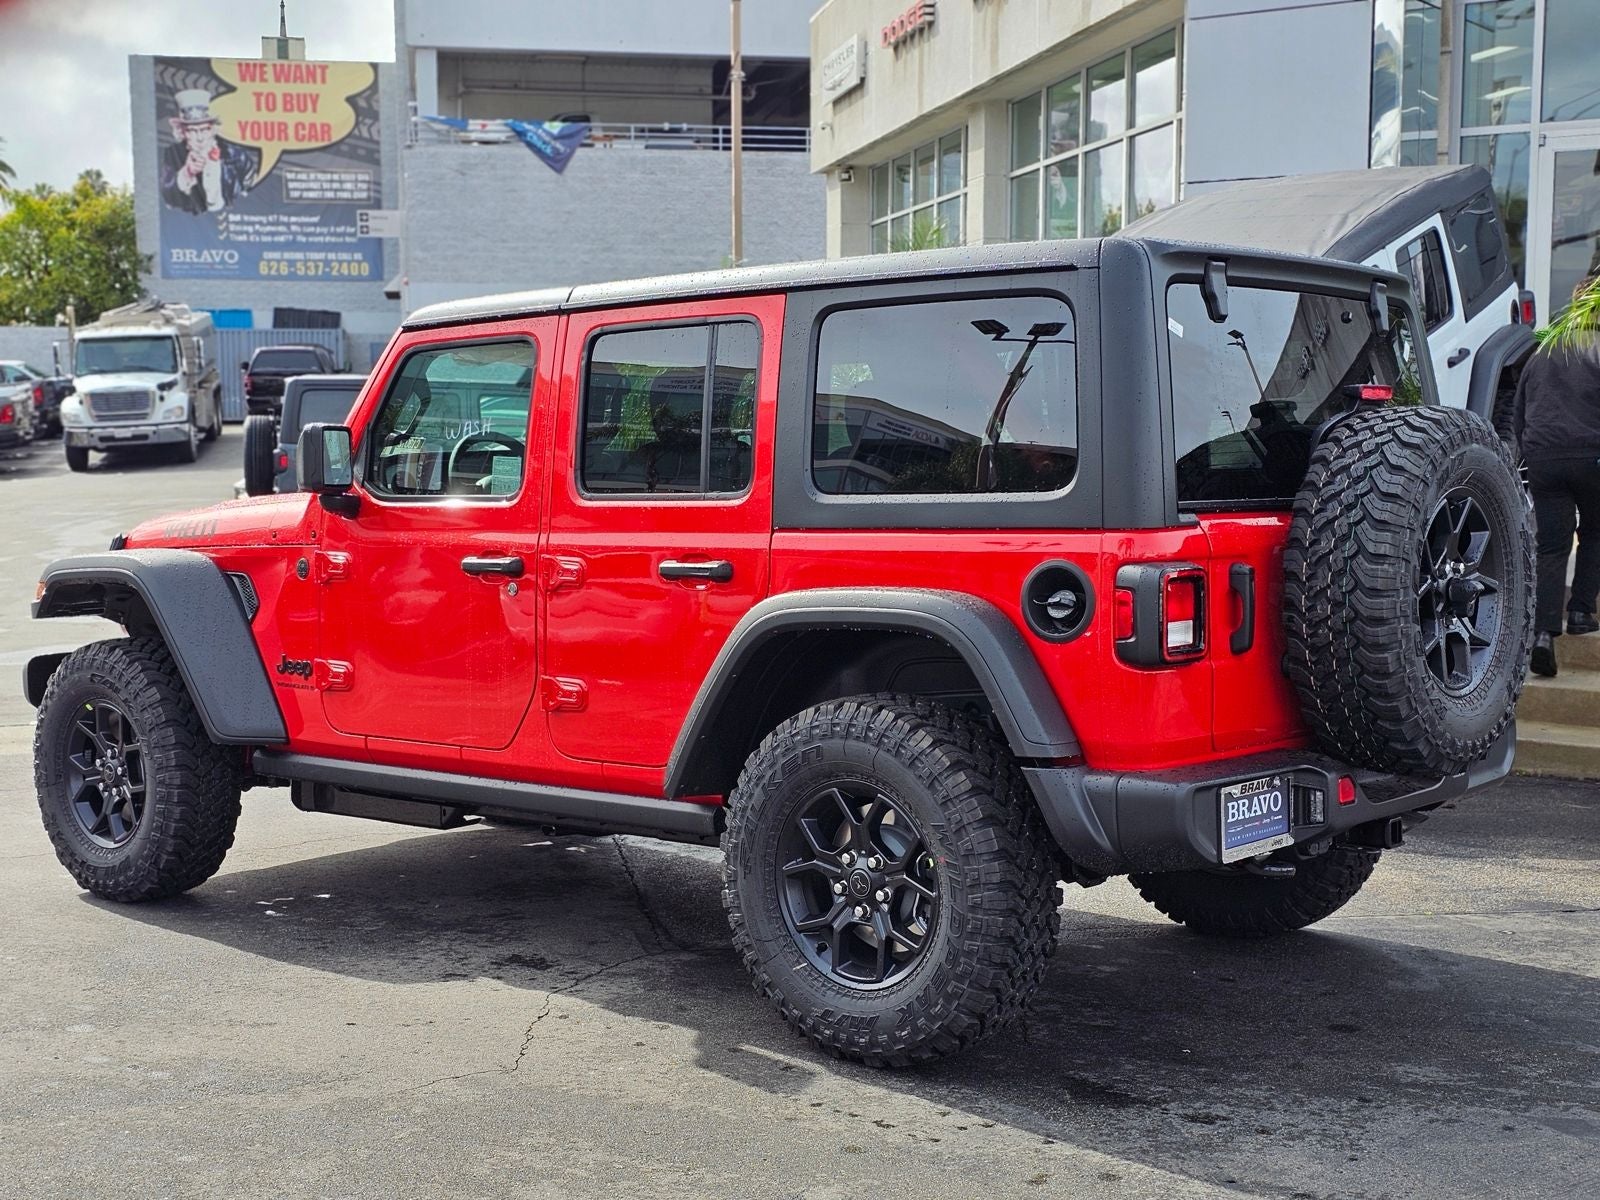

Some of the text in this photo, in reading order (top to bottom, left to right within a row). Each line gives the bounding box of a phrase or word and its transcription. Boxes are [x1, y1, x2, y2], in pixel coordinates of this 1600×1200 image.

[881, 0, 926, 48] DODGE
[237, 62, 329, 85] WE WANT
[252, 92, 320, 114] TO BUY
[238, 120, 332, 143] YOUR CAR
[171, 248, 239, 264] BRAVO
[259, 261, 369, 276] 626-537-2400
[444, 417, 495, 440] WASH
[276, 653, 314, 681] Jeep
[1240, 776, 1276, 796] BRAVO
[1227, 791, 1282, 823] BRAVO
